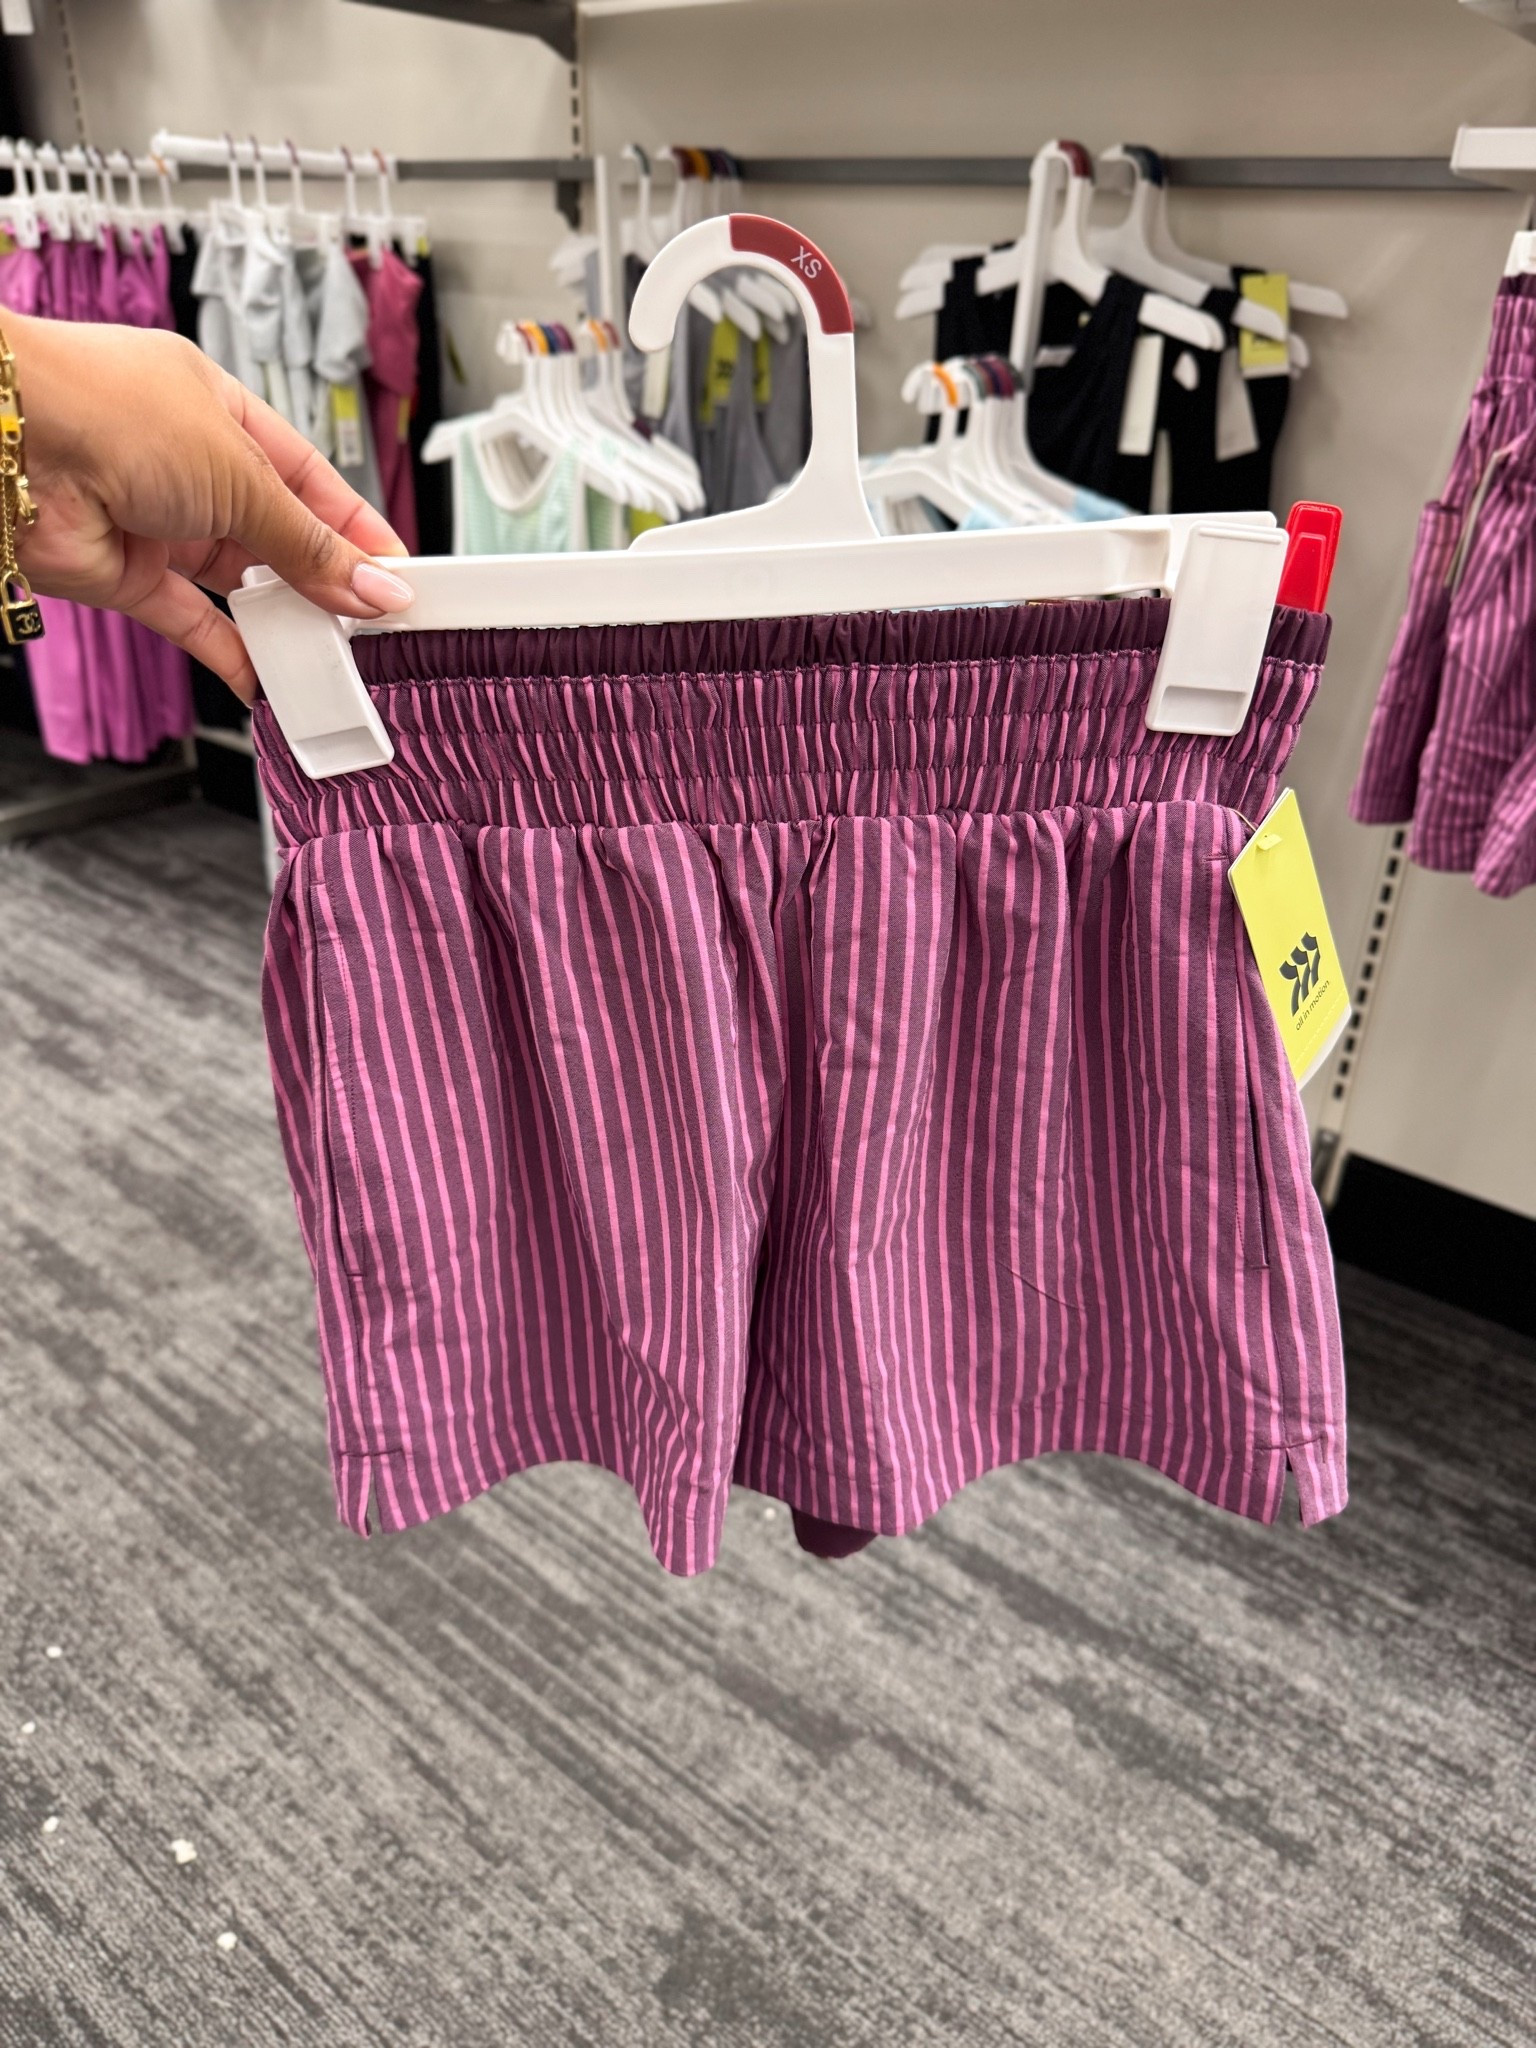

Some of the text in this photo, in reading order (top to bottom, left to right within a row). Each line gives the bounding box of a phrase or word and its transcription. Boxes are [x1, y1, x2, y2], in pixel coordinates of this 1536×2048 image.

[790, 245, 822, 279] XS
[1296, 980, 1330, 1031] all in motion
